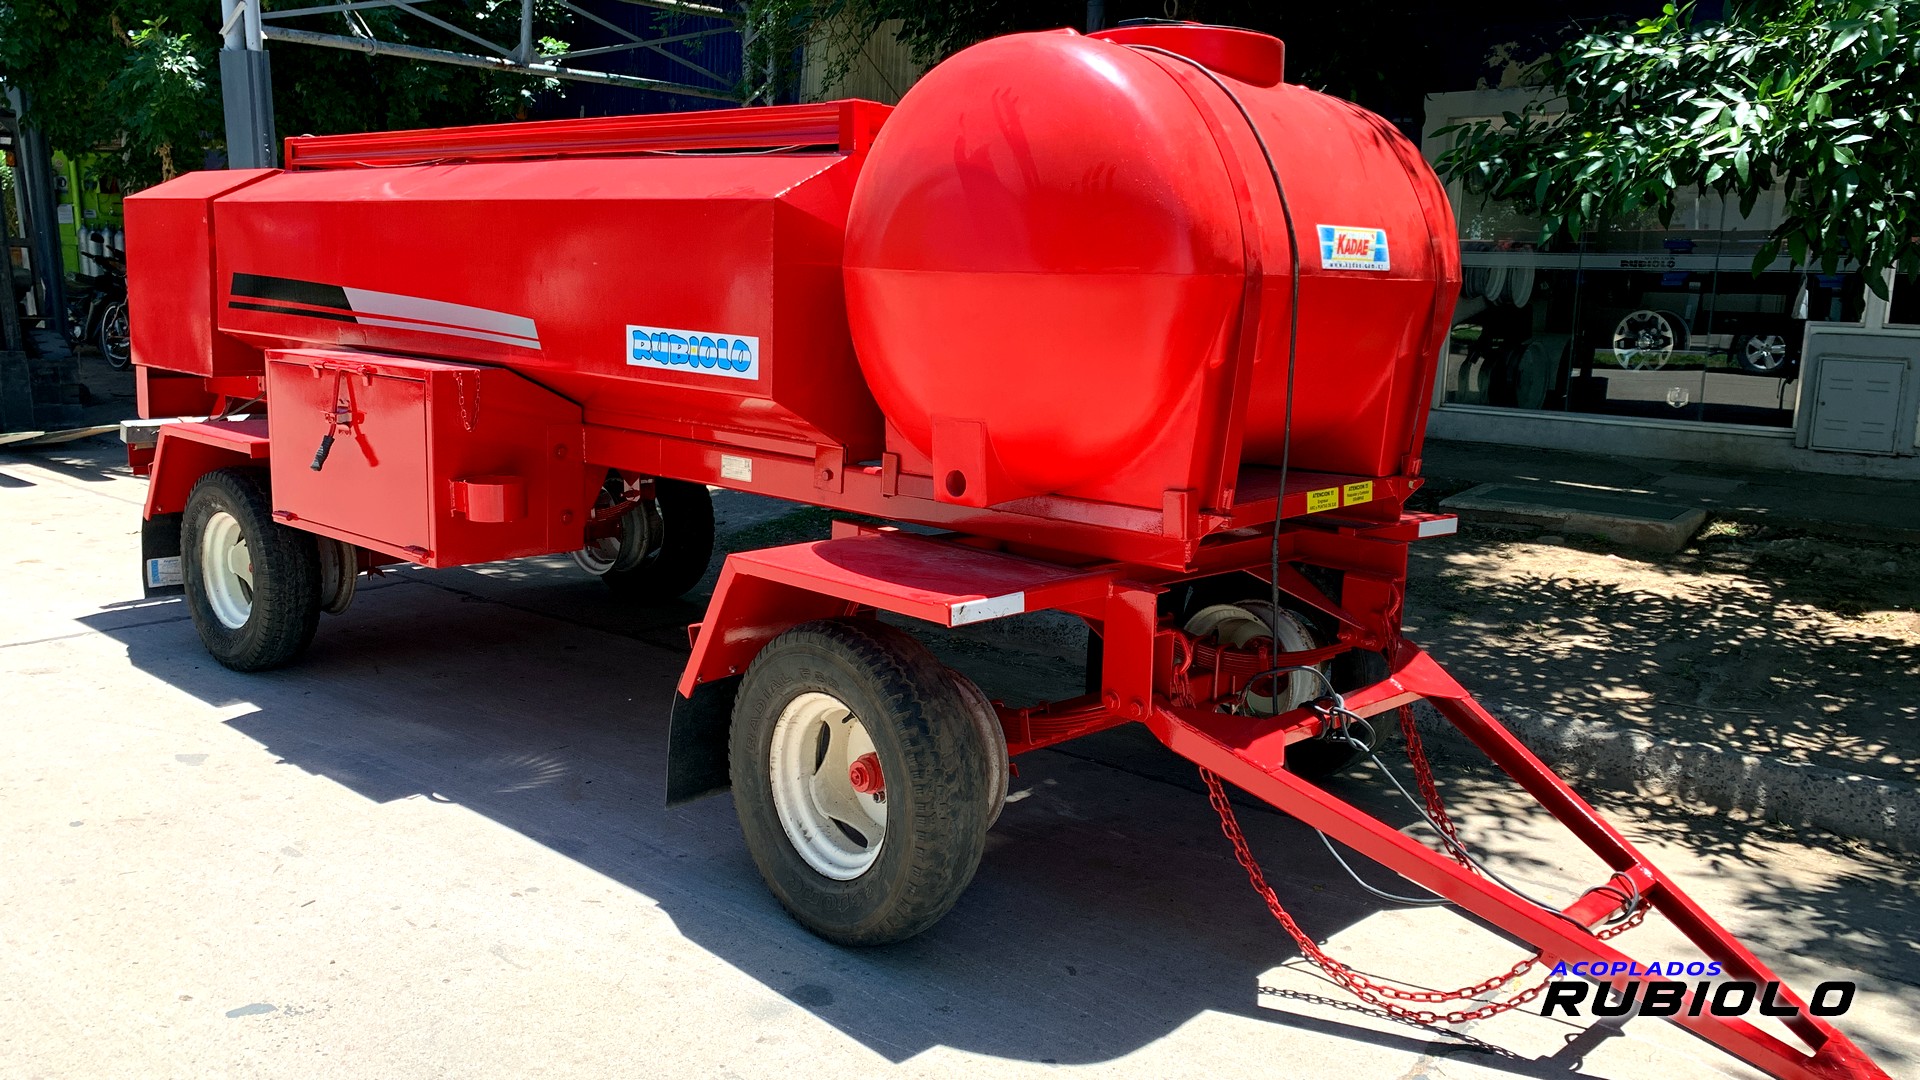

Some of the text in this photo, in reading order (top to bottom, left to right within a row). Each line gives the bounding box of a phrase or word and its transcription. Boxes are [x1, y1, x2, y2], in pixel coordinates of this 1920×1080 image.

[633, 330, 751, 372] RUBIOLO
[1312, 491, 1330, 499] ATENCION
[746, 673, 792, 753] RADIAL
